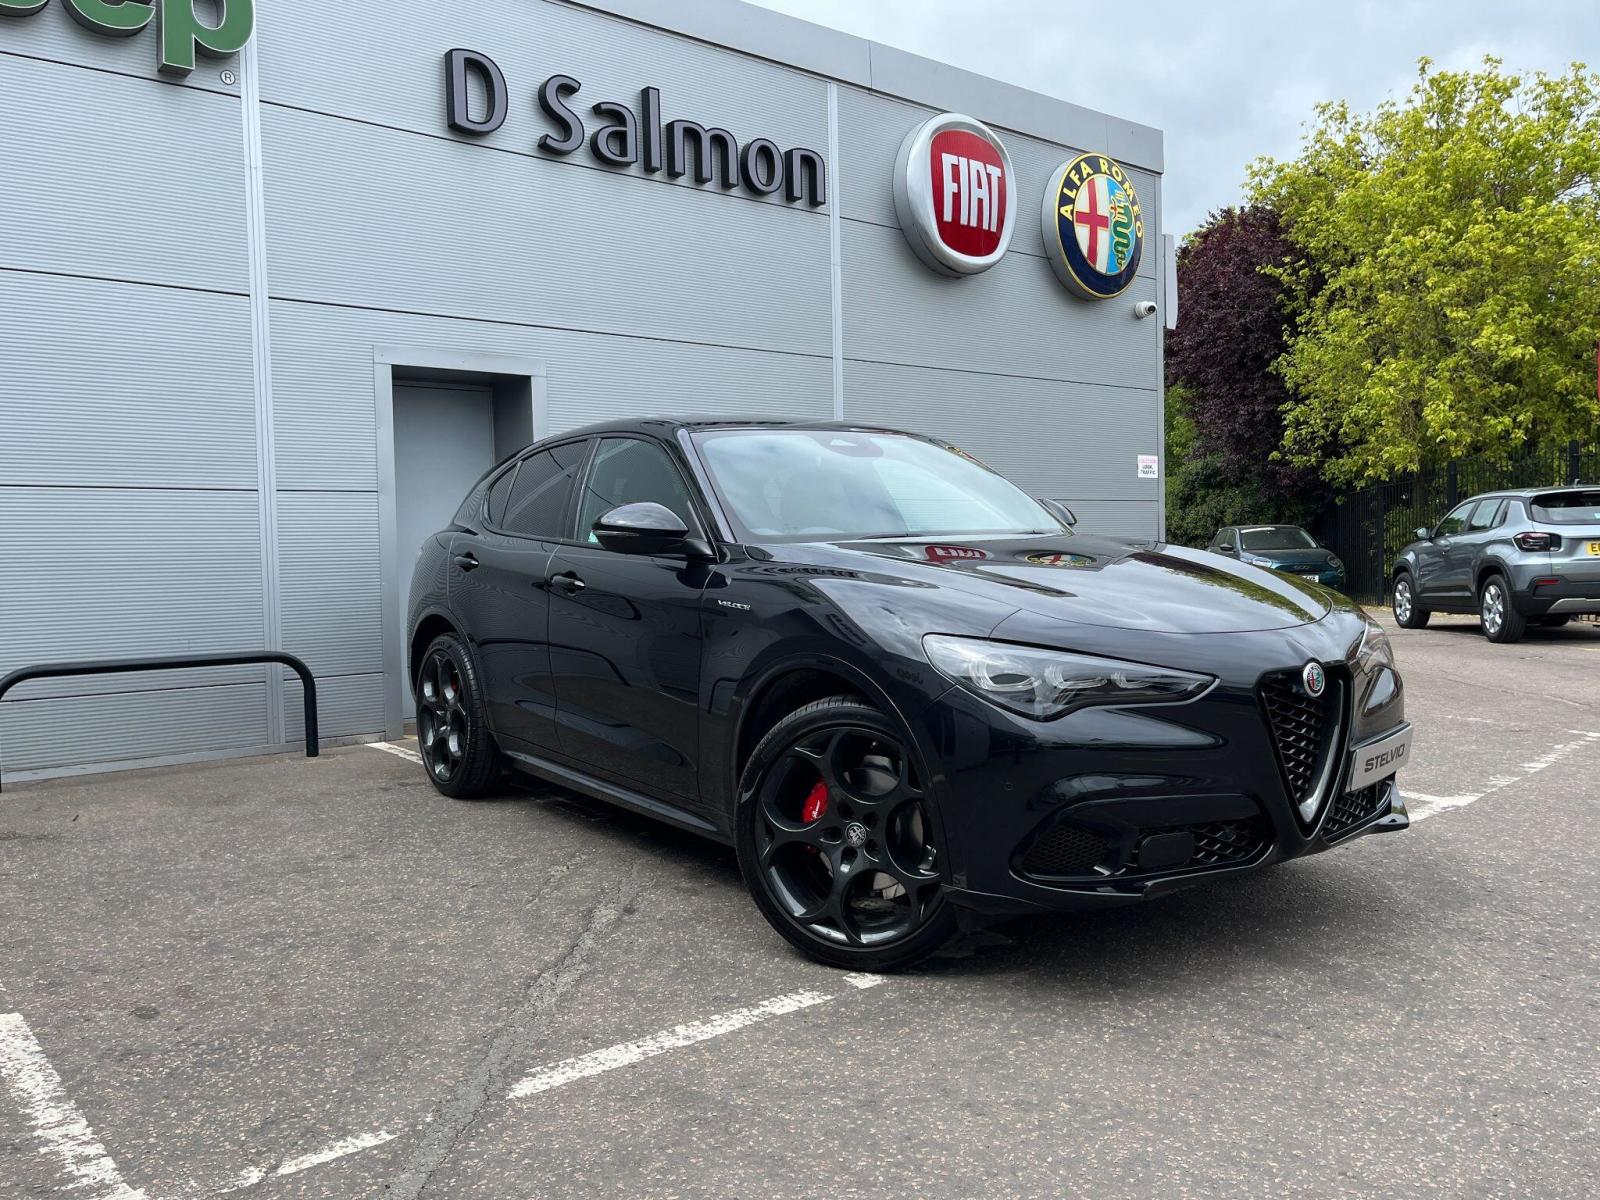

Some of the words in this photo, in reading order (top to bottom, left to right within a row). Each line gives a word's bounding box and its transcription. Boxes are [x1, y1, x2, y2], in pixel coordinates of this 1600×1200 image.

[444, 48, 508, 137] D
[538, 74, 826, 207] Salmon
[941, 152, 1002, 233] FIAT
[1060, 160, 1094, 222] ALFA
[1099, 158, 1143, 238] ROMEO
[1364, 743, 1406, 773] STELVIO
